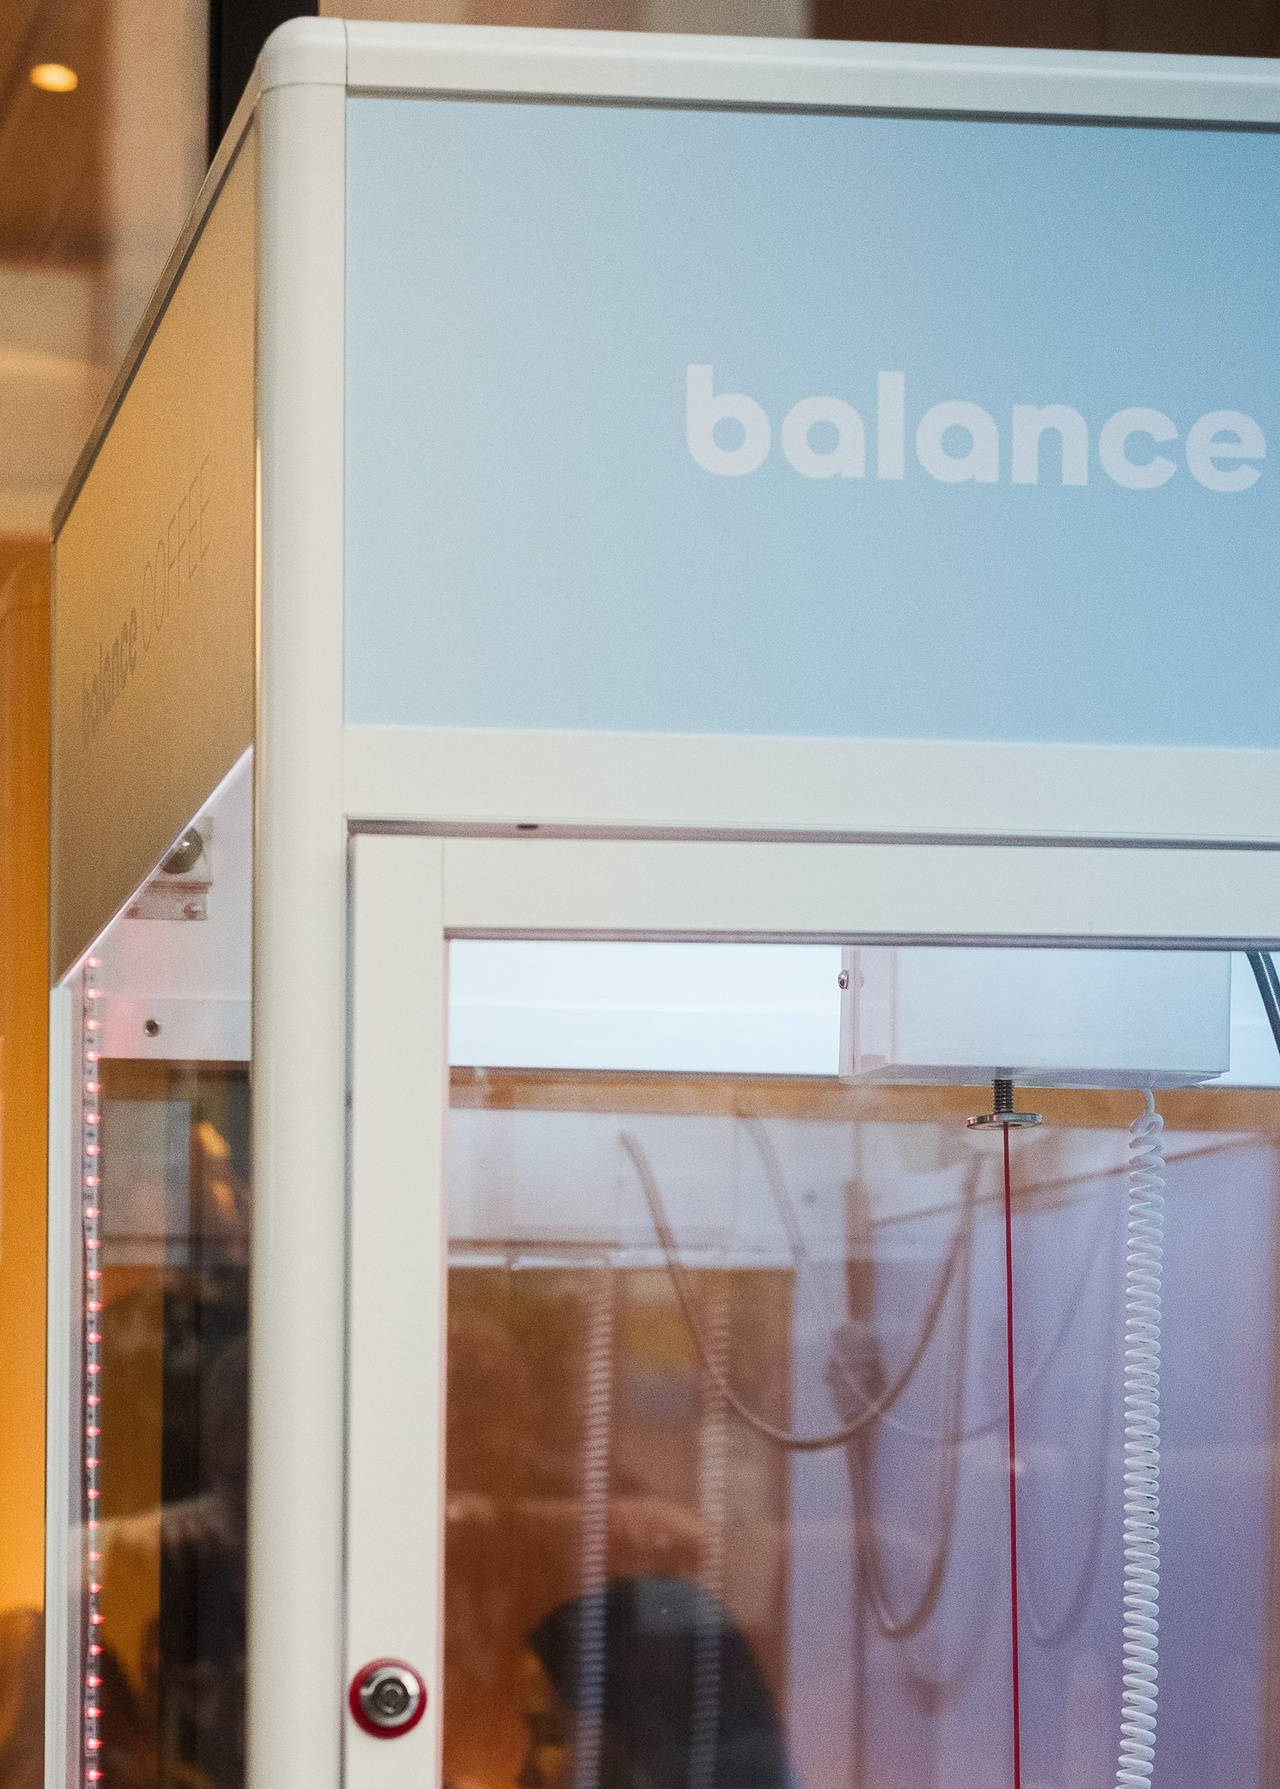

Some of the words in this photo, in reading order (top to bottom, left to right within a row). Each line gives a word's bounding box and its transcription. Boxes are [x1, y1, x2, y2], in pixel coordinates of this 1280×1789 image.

[686, 363, 1267, 493] balance
[80, 606, 138, 750] balance
[140, 453, 210, 653] COFFEE
